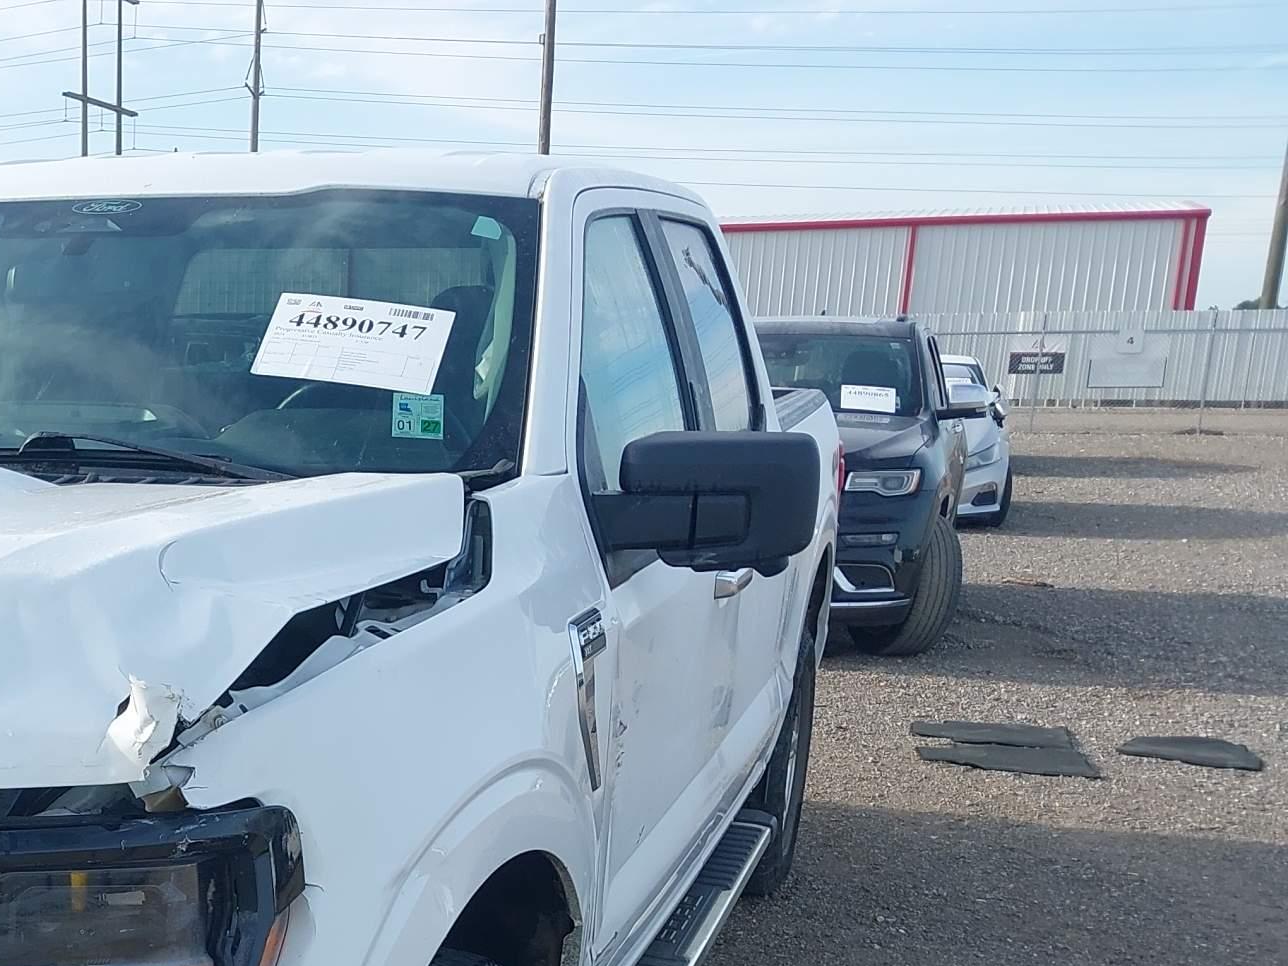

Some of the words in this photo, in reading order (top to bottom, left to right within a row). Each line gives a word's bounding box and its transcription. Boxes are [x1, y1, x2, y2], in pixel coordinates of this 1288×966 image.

[82, 201, 131, 212] Ford
[288, 313, 428, 340] 44890747
[275, 326, 316, 335] Progressive
[317, 329, 347, 338] Casualty
[349, 332, 385, 341] Insurance
[1127, 337, 1135, 345] 4
[1017, 363, 1036, 371] ZONE
[397, 420, 412, 431] 01
[423, 420, 440, 432] 27
